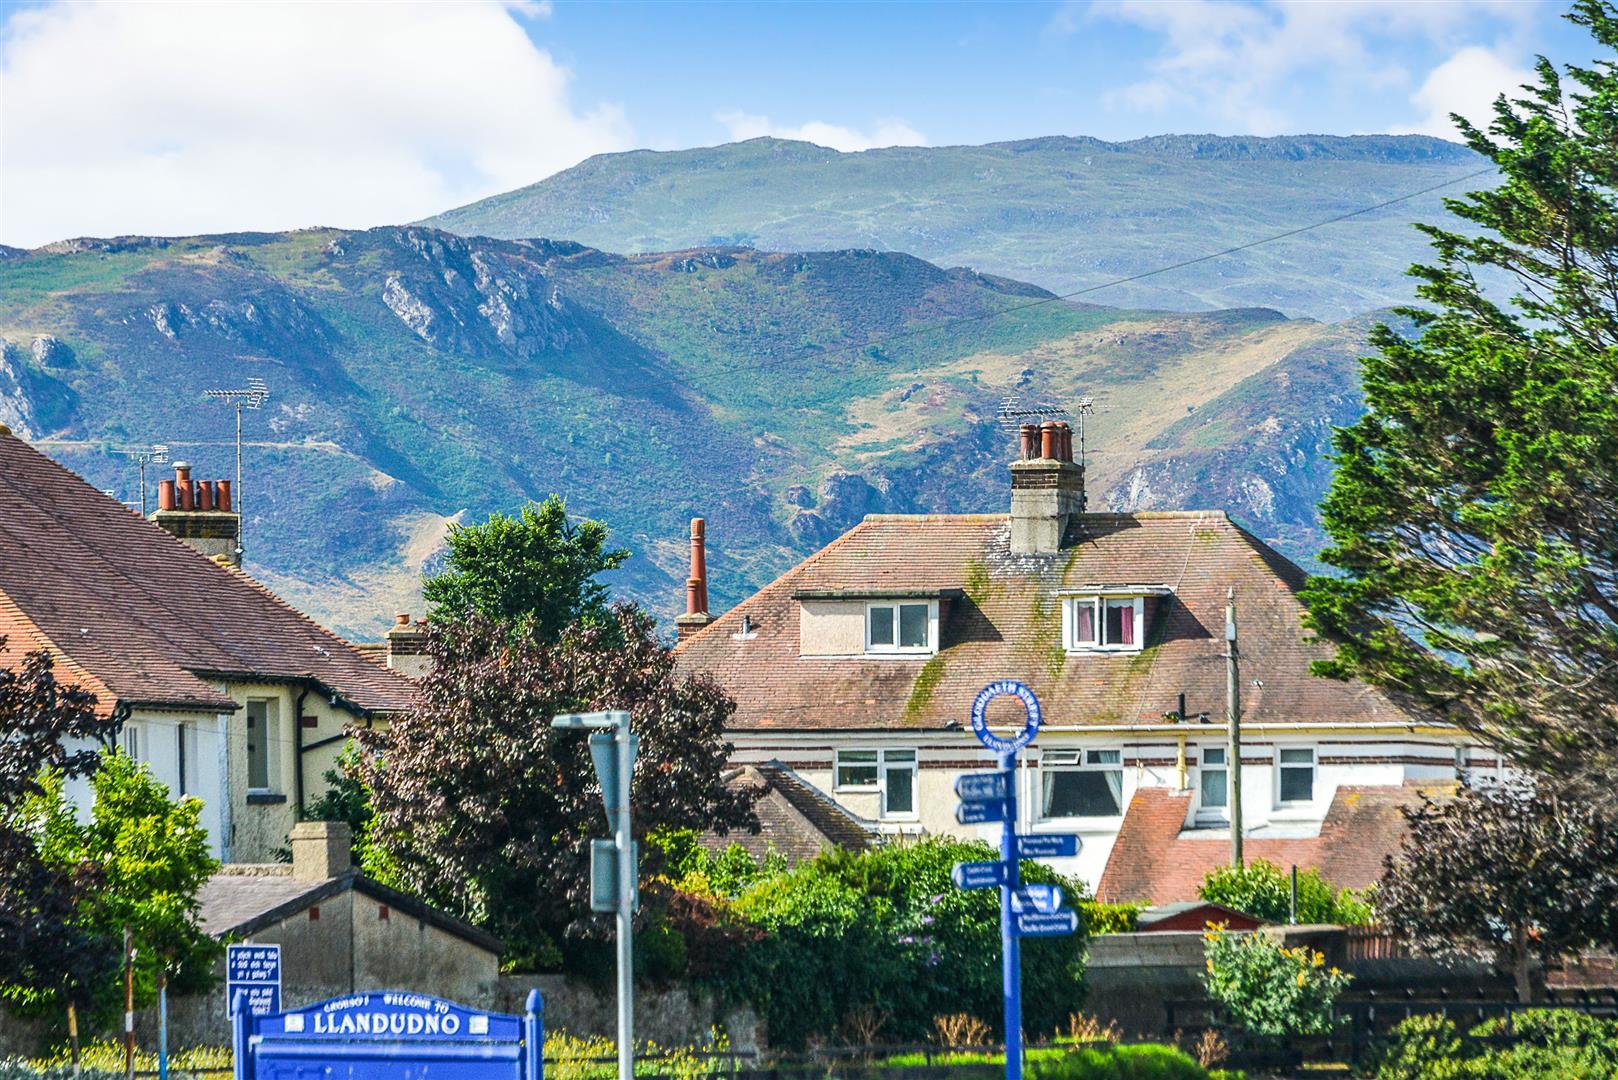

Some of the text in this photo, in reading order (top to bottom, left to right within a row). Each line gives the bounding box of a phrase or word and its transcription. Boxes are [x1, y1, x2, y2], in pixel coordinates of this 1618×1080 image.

[1017, 686, 1039, 728] STREET
[383, 993, 449, 1014] WELCOME TO
[314, 1012, 460, 1035] LLANDUDNO
